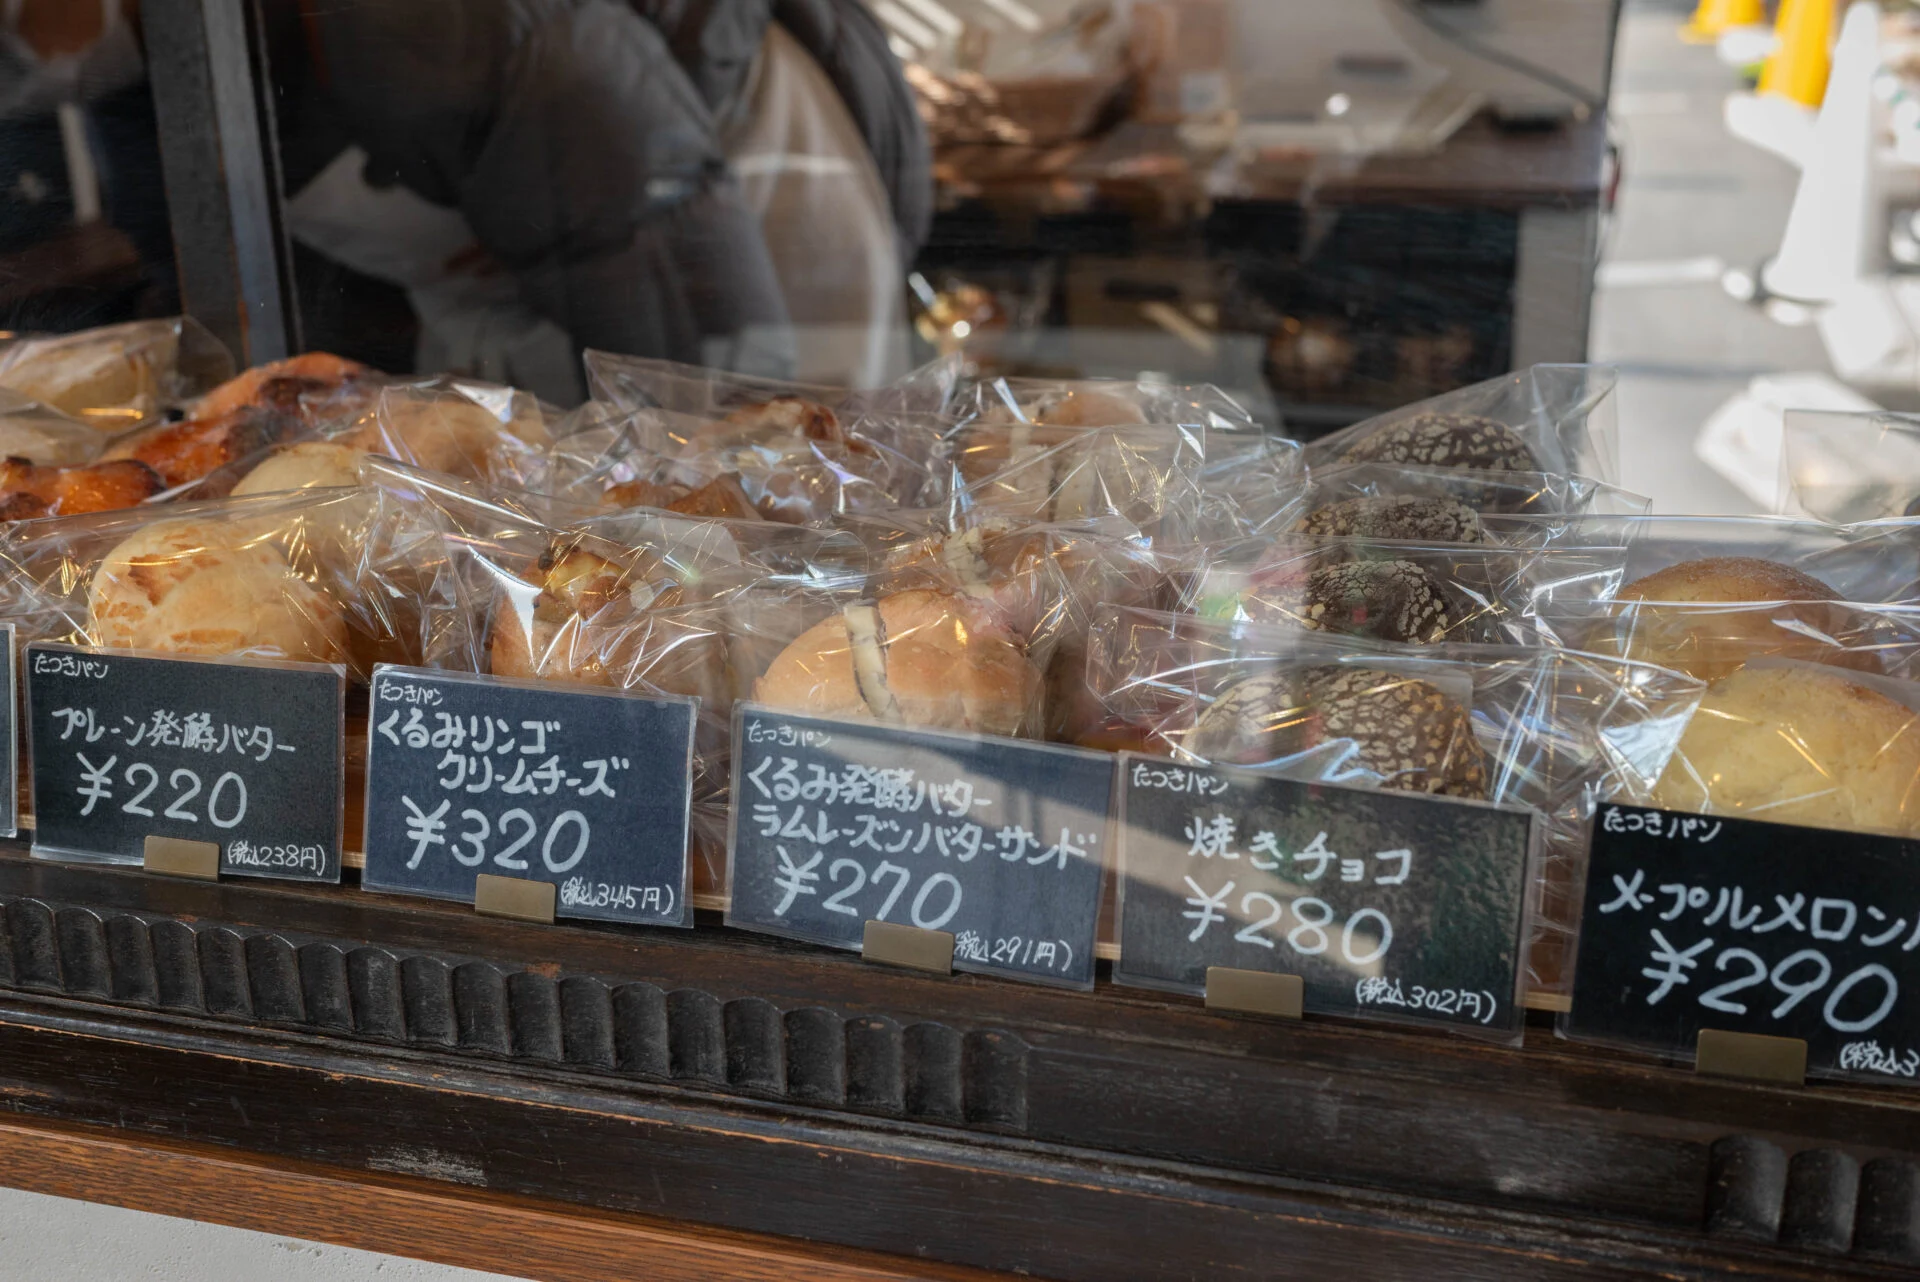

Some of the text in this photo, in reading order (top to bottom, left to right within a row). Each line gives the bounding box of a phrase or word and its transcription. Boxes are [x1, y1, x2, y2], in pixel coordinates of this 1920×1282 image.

[34, 653, 108, 678] たつきパン
[378, 679, 443, 706] たつきパン
[52, 707, 296, 762] プレーン発酵バター
[378, 708, 560, 755] くるみリンゴ
[747, 720, 831, 748] たつきパン
[76, 752, 248, 828] ¥220
[437, 749, 630, 798] クリームチーズ
[748, 756, 992, 817] くるみ発酵バター
[1132, 763, 1229, 796] たつきパン
[402, 795, 590, 873] ¥320
[753, 804, 1096, 870] ラムレーズンバターサンド
[1185, 814, 1412, 885] 焼きチョコ
[1604, 806, 1722, 842] たつきパン
[774, 846, 963, 930] ¥270
[1183, 875, 1394, 965] ¥280
[1642, 929, 1898, 1032] ¥290
